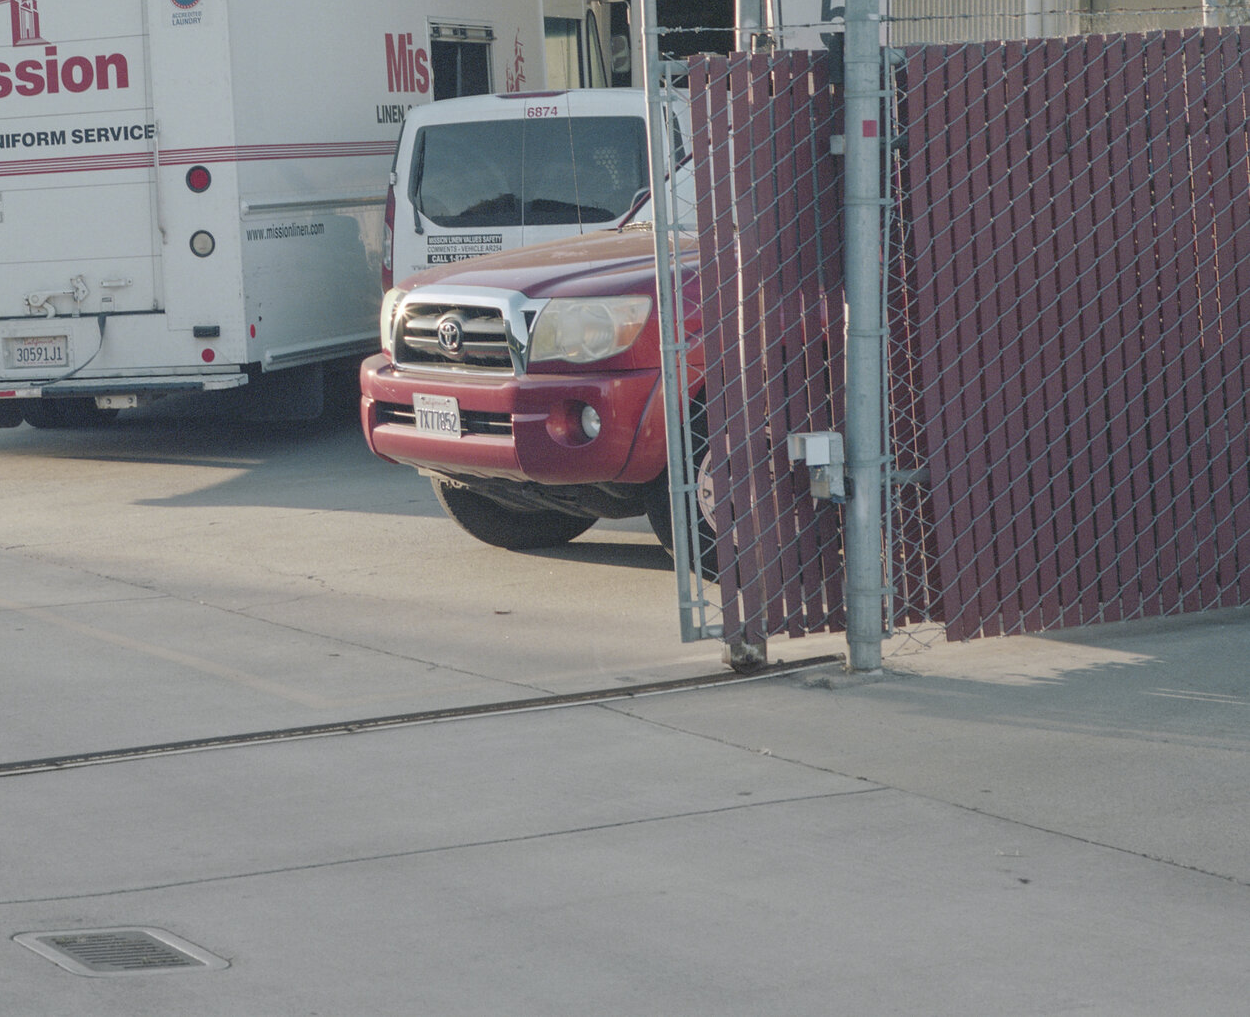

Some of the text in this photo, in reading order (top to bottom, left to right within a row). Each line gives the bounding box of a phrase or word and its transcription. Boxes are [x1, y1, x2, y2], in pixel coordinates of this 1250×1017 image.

[172, 17, 202, 26] LAUNDRY
[527, 106, 558, 118] 6874
[71, 124, 156, 144] SERVICE
[246, 222, 325, 241] www.missionlinen.com
[449, 235, 463, 243] LINEN
[463, 235, 482, 243] VALUES
[483, 234, 502, 242] SAFETY
[427, 245, 457, 253] COMMENTS
[461, 245, 484, 253] VEHICLE
[431, 255, 449, 263] CALL
[16, 346, 63, 363] 30591J1
